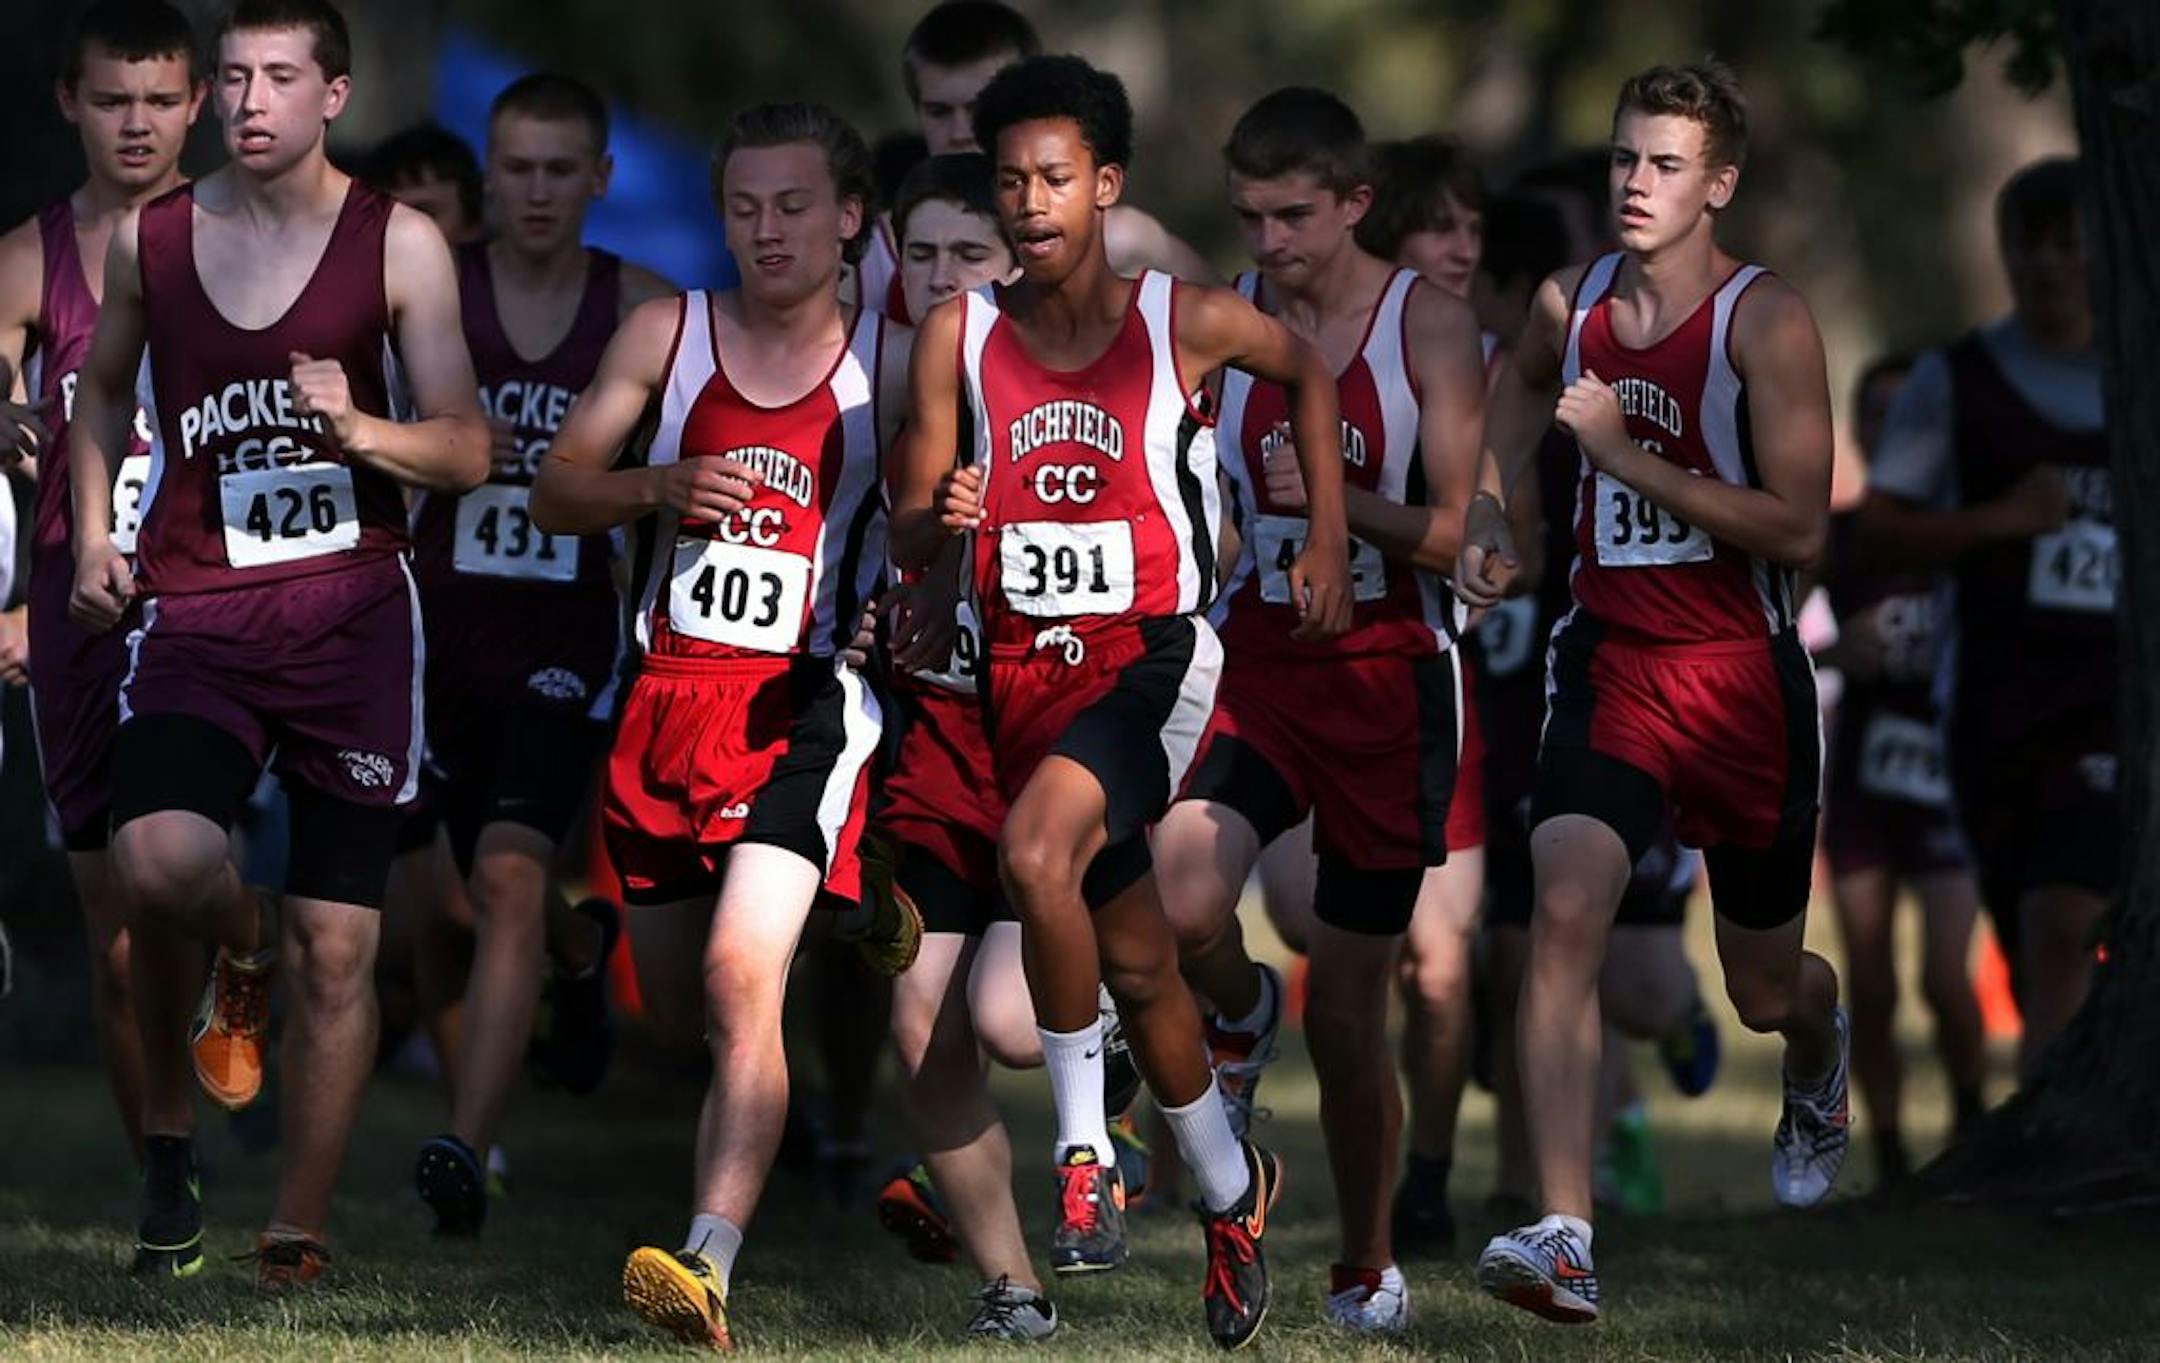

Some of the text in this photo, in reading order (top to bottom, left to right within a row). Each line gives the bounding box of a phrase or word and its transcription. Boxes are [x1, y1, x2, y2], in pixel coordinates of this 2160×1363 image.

[1009, 400, 1124, 462] RICHFIELD
[1034, 463, 1097, 504] CC
[246, 483, 338, 543] 426
[719, 507, 783, 547] CC
[690, 564, 784, 628] 403
[1022, 545, 1110, 597] 391
